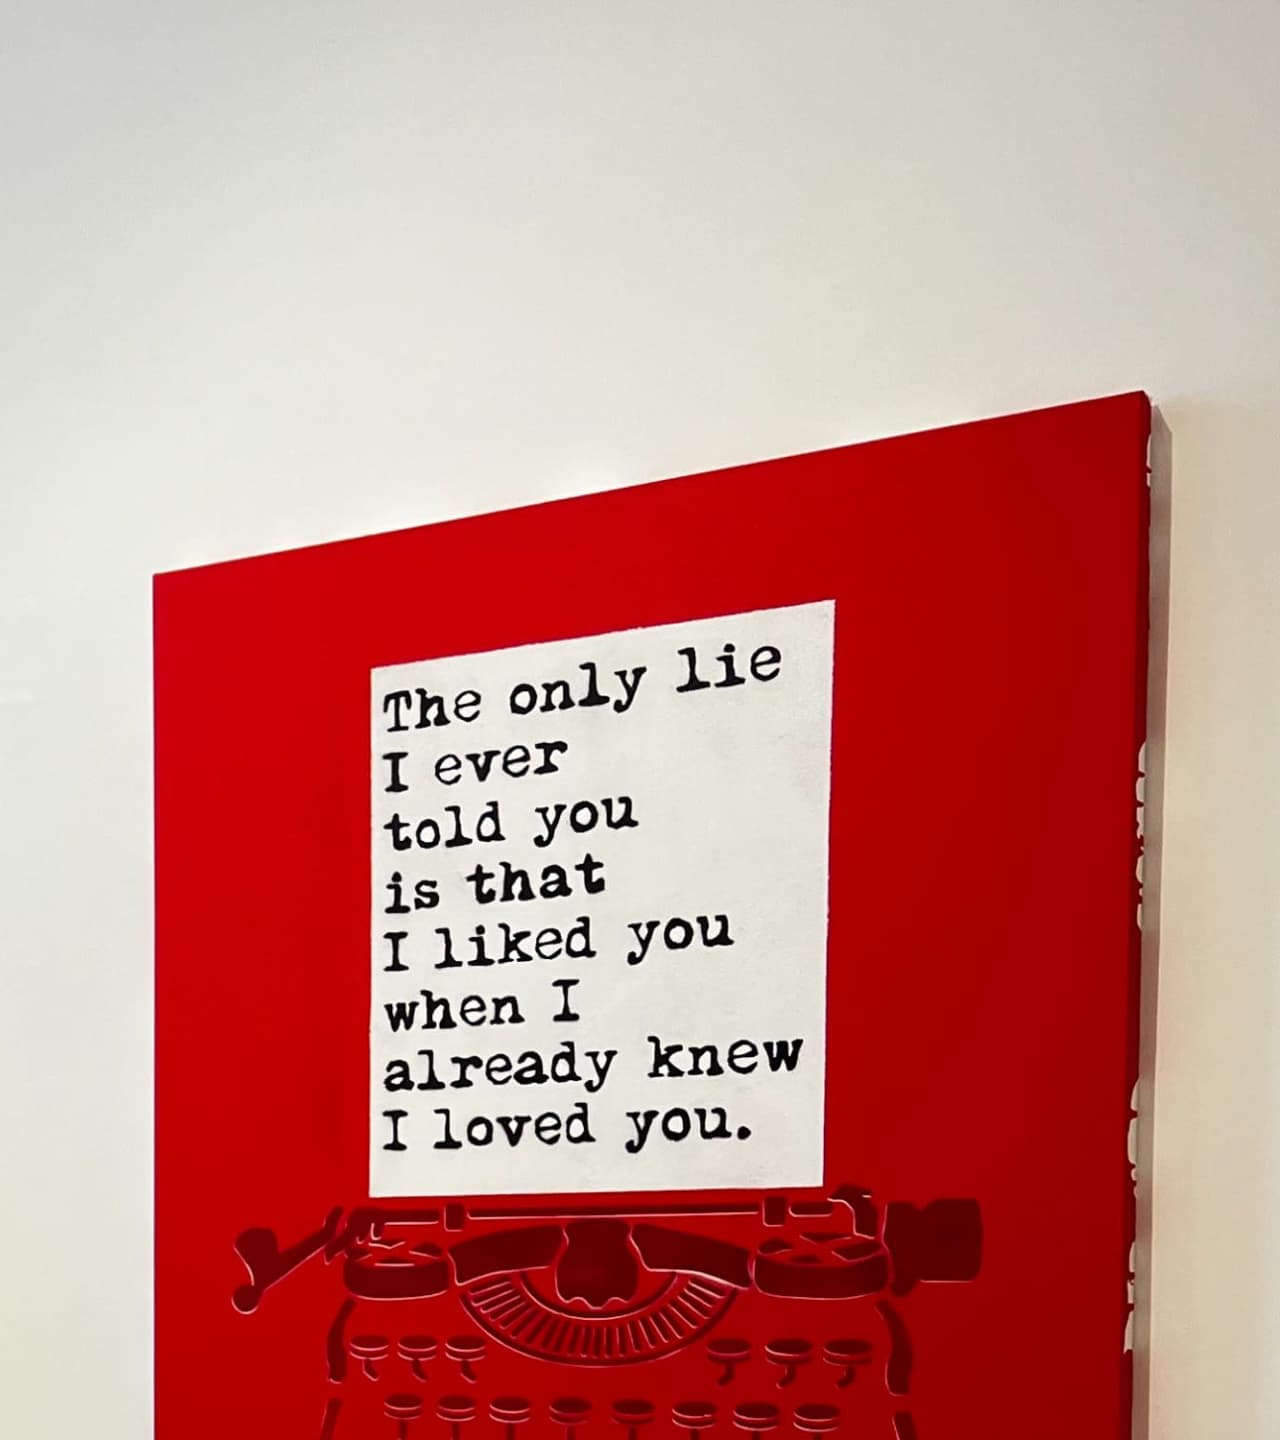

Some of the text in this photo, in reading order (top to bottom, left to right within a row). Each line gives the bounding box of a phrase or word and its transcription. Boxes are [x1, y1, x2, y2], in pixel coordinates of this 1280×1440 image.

[383, 643, 782, 733] The only lie
[382, 740, 568, 793] I ever
[383, 796, 639, 851] told you
[384, 853, 606, 914] is that
[383, 914, 735, 972] I liked you
[383, 979, 580, 1033] when I
[383, 1035, 804, 1093] already knew
[382, 1102, 752, 1154] I loved you.
